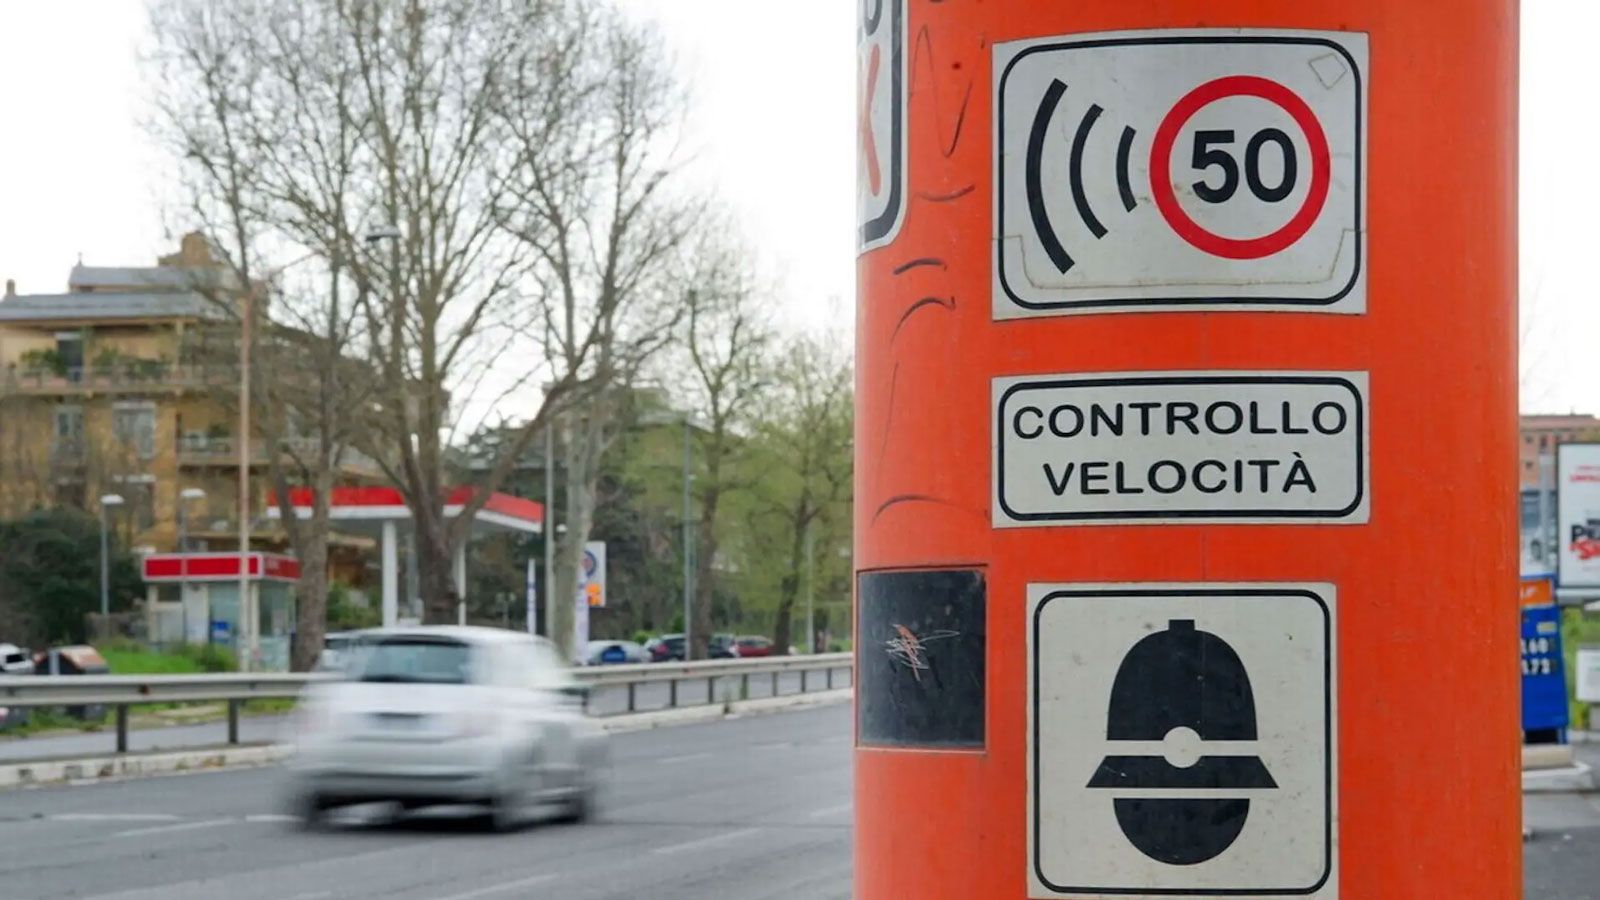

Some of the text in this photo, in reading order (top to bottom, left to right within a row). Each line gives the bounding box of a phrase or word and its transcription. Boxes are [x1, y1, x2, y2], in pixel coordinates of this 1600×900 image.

[1191, 127, 1298, 204] 50
[1013, 400, 1348, 440] CONTROLLO
[1043, 451, 1317, 496] VELOCITÀ
